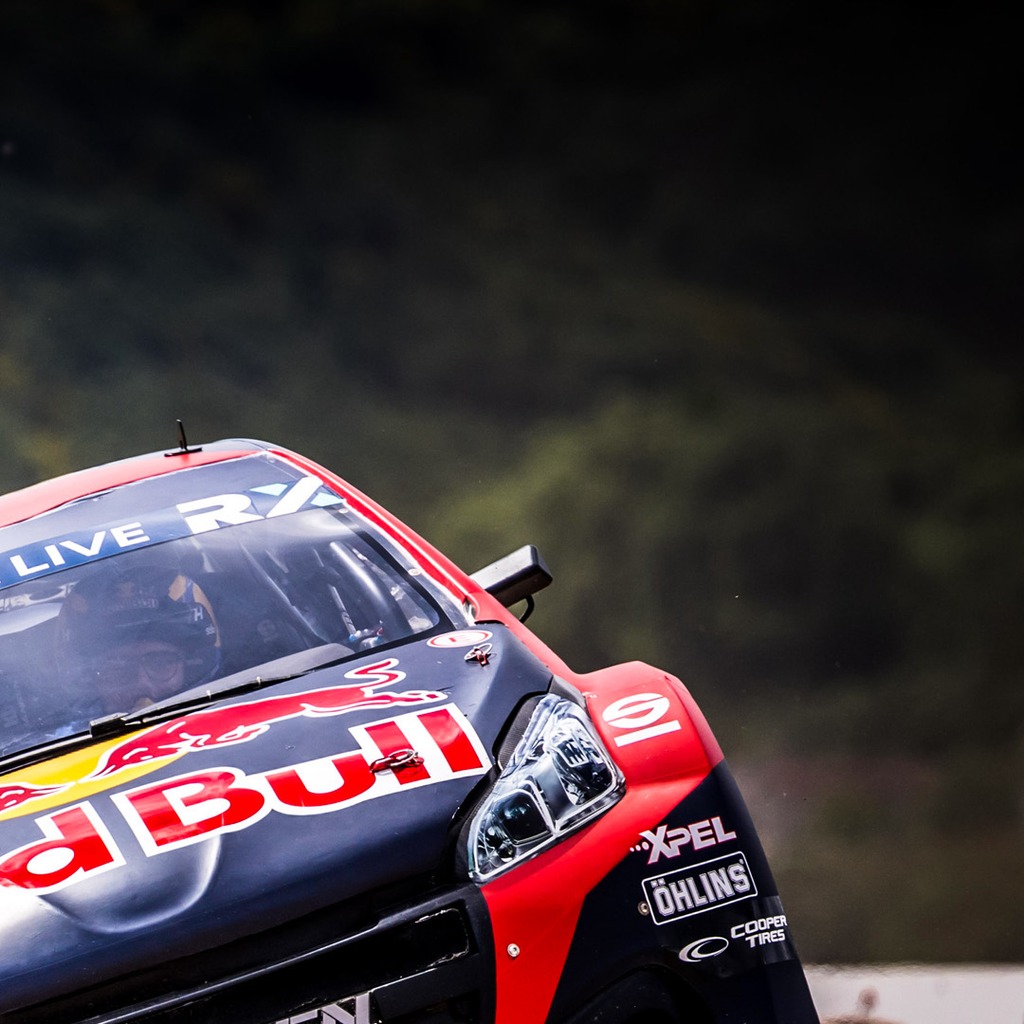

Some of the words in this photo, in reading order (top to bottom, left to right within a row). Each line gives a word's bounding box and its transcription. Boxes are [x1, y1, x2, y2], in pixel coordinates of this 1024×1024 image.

[10, 522, 151, 577] LIVE
[176, 476, 347, 535] RX
[110, 703, 491, 857] Bull
[639, 816, 737, 865] XPEL
[650, 862, 751, 917] ÖHLINS
[730, 914, 788, 939] COOPER
[744, 928, 786, 948] TIRES
